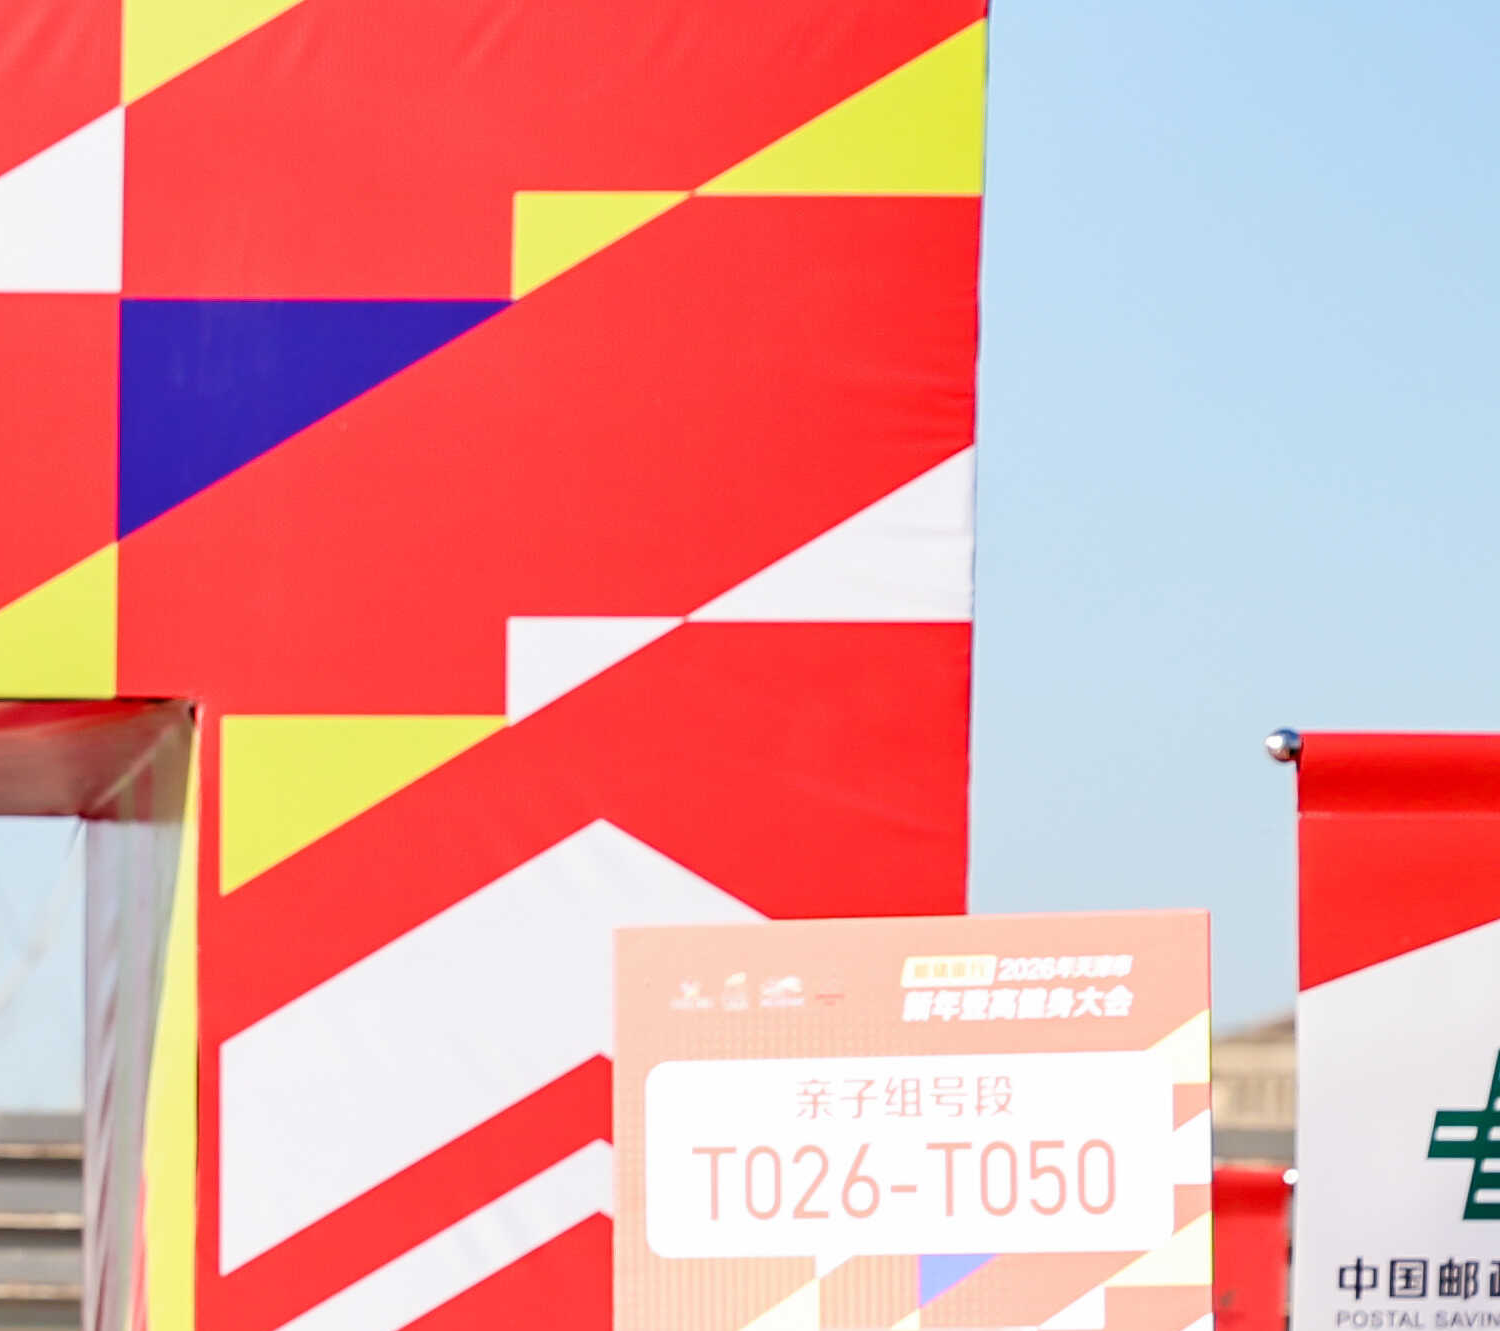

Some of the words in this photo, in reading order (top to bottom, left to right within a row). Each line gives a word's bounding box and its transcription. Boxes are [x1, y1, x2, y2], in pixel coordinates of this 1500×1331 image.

[796, 1075, 1014, 1120] 亲子组号段
[692, 1138, 1117, 1221] T026-T050
[1338, 1257, 1500, 1301] 中国邮
[1336, 1310, 1425, 1329] POSTAL
